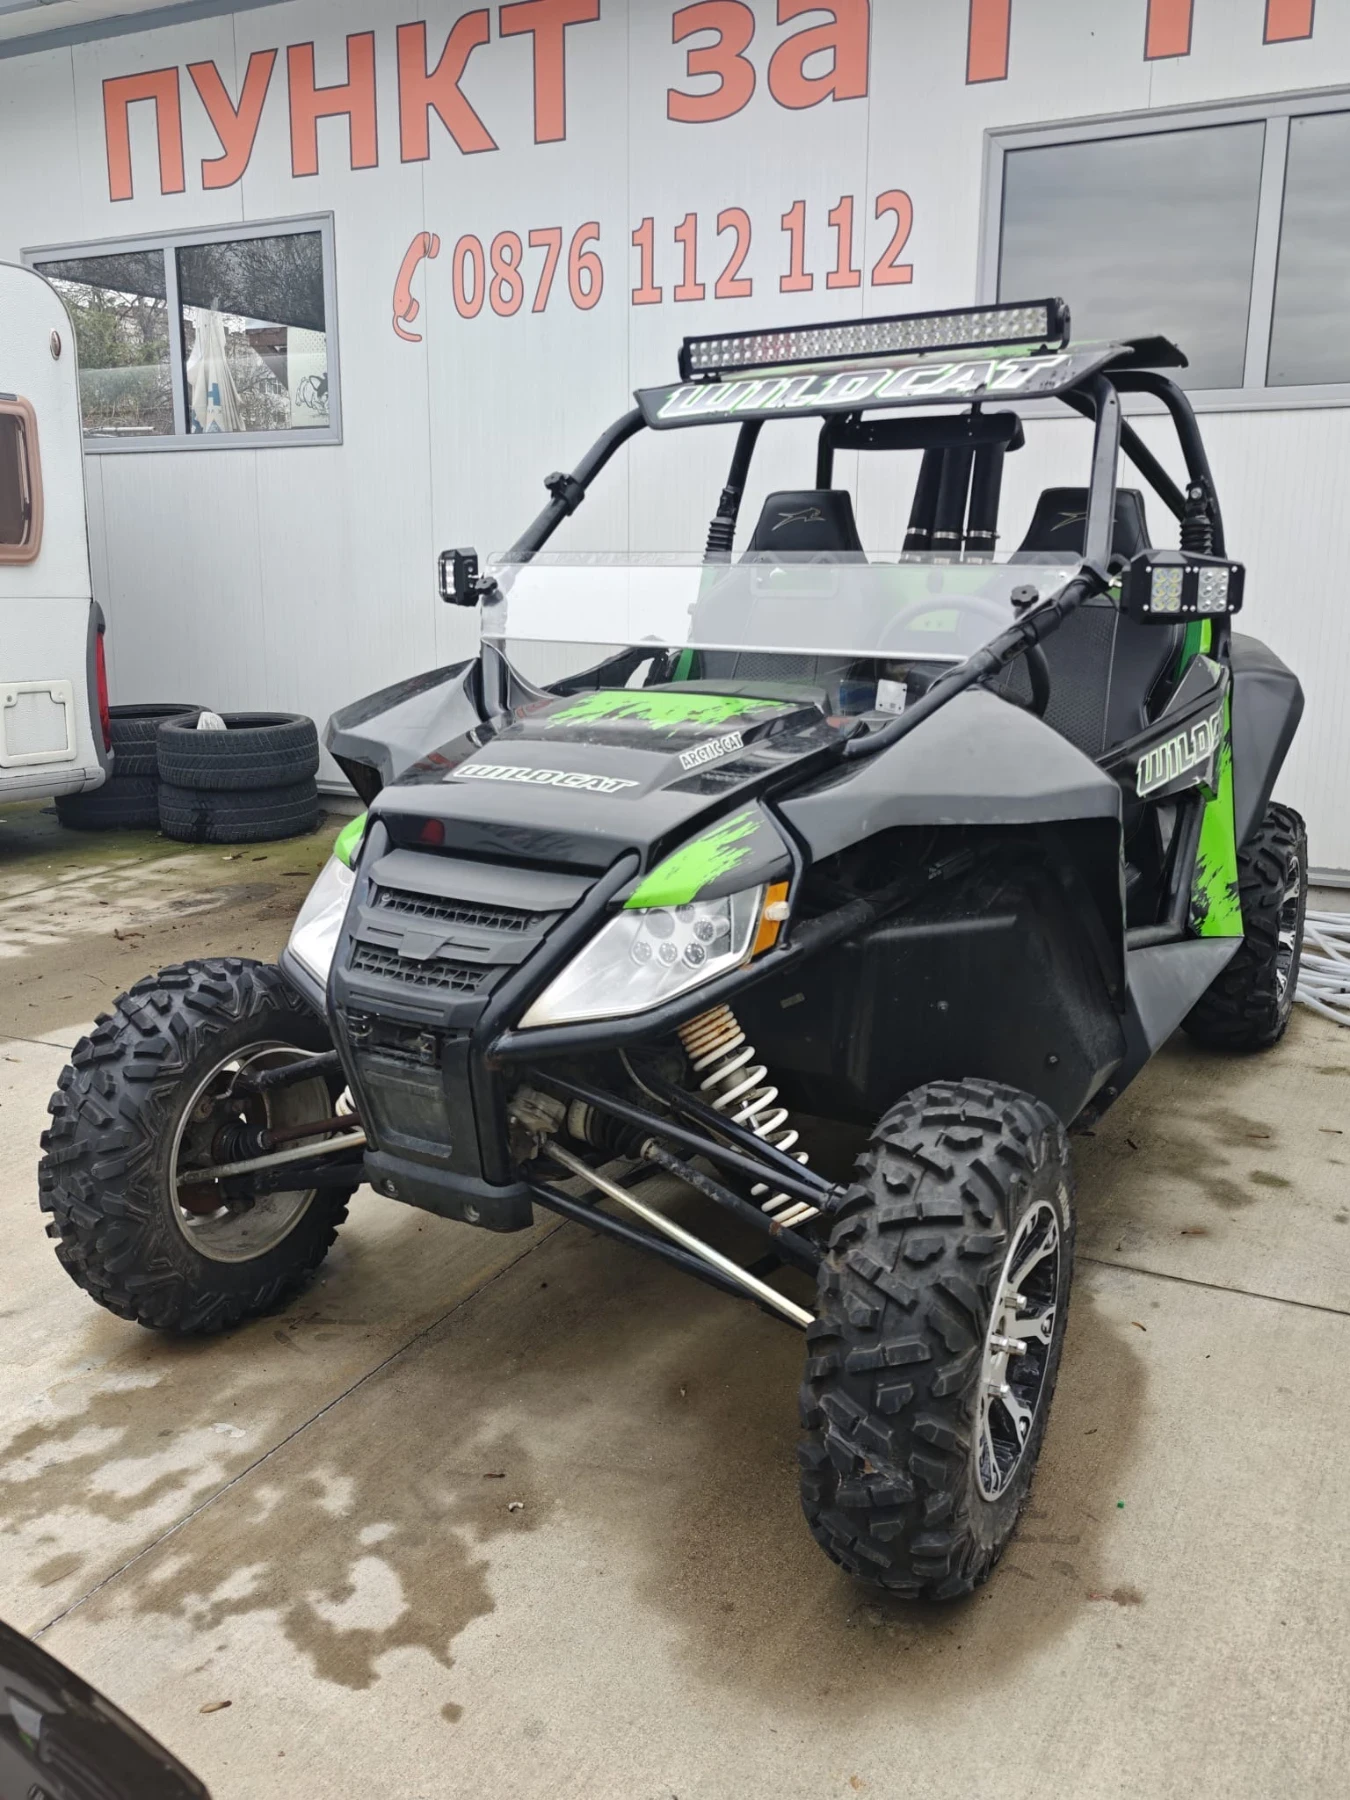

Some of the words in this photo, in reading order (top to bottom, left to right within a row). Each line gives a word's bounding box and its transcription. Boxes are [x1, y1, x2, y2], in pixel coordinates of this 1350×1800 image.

[102, 0, 600, 202] ПУНКТ
[452, 221, 604, 319] 0876
[631, 208, 753, 305] 112
[779, 189, 914, 293] 112
[657, 354, 1070, 419] WILDCAT
[453, 764, 641, 793] WILDCAT
[679, 739, 724, 770] ARCTIC
[720, 731, 744, 753] CAT
